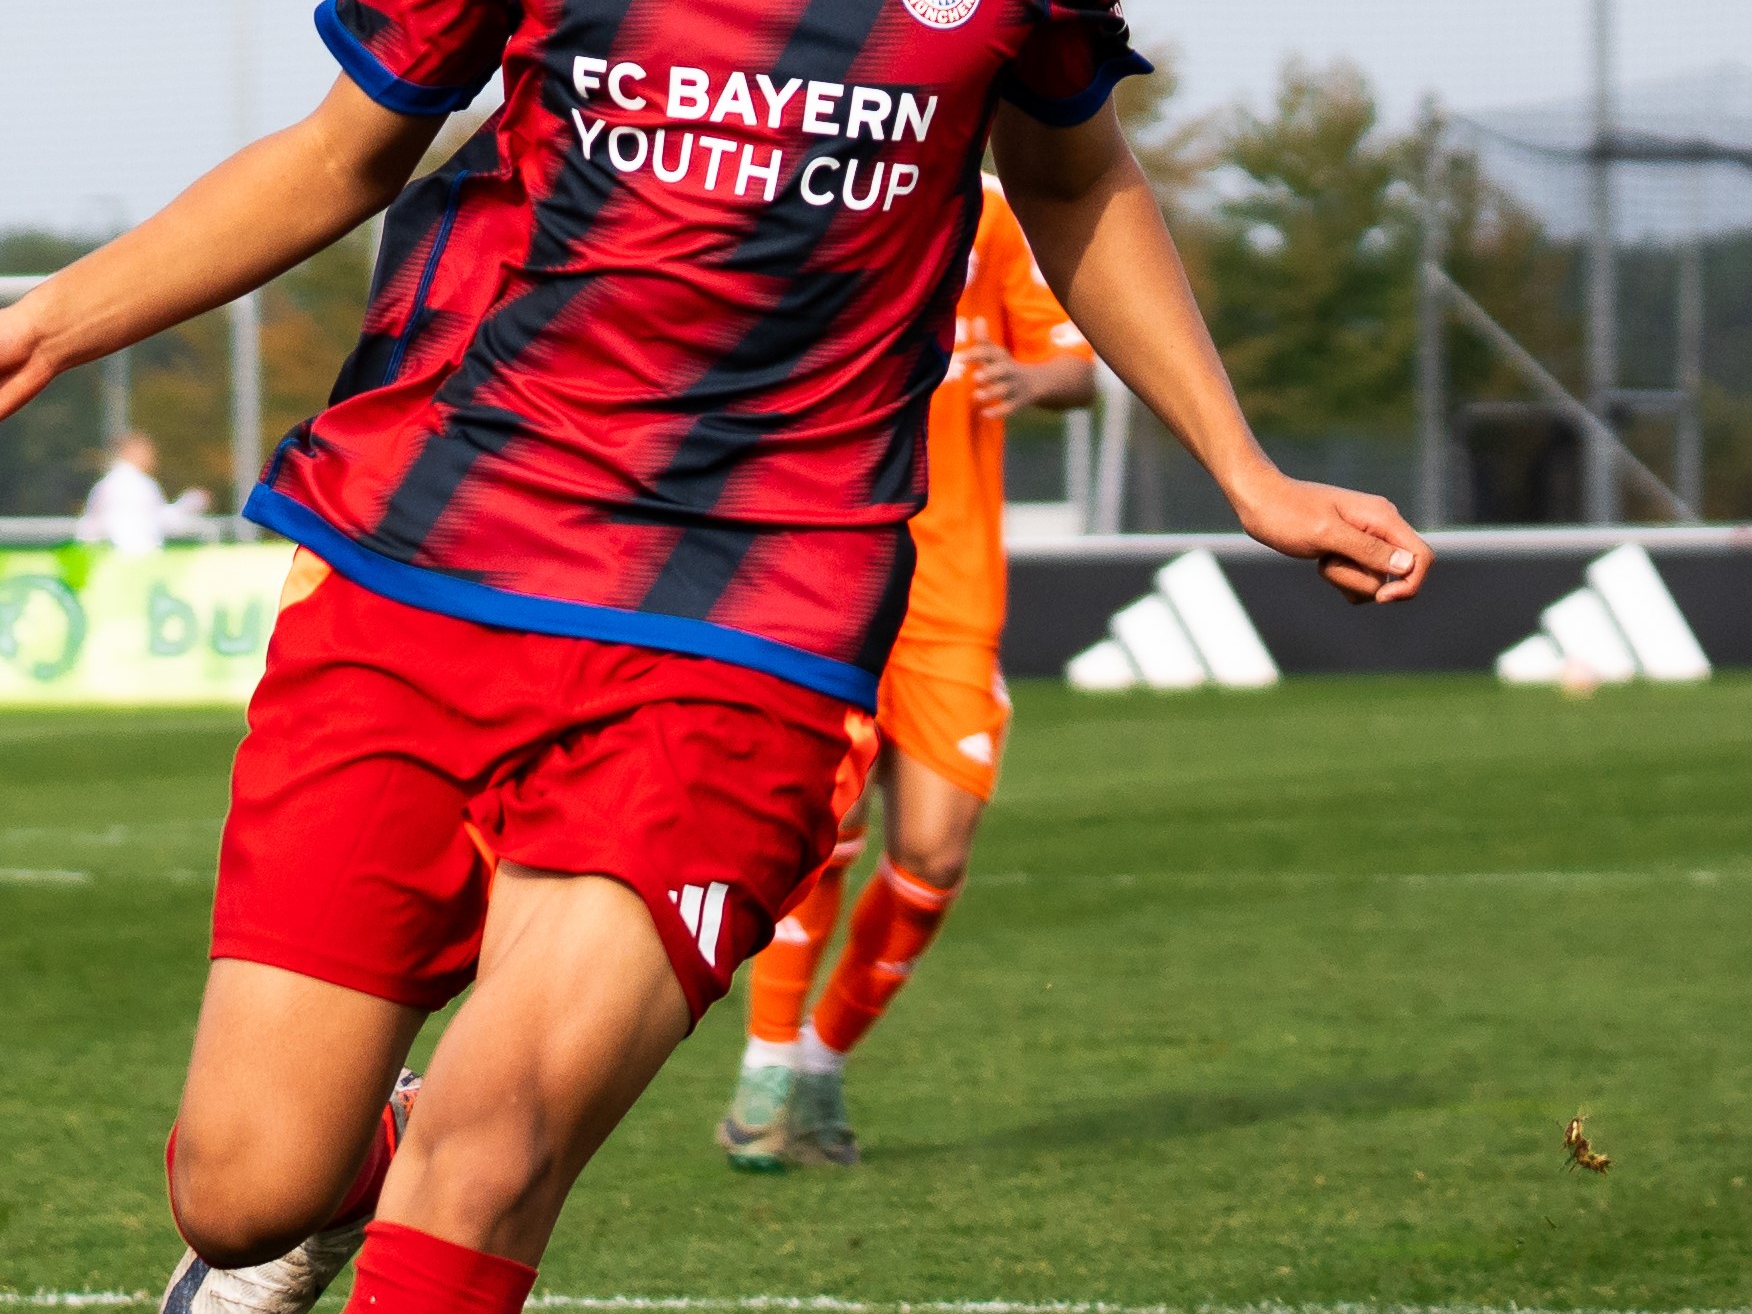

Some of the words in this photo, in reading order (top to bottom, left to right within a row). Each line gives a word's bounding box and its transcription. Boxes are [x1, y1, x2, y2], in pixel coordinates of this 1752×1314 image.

[572, 55, 647, 111] FC
[666, 65, 938, 143] BAYERN
[571, 107, 783, 202] YOUTH
[800, 156, 920, 212] CUP
